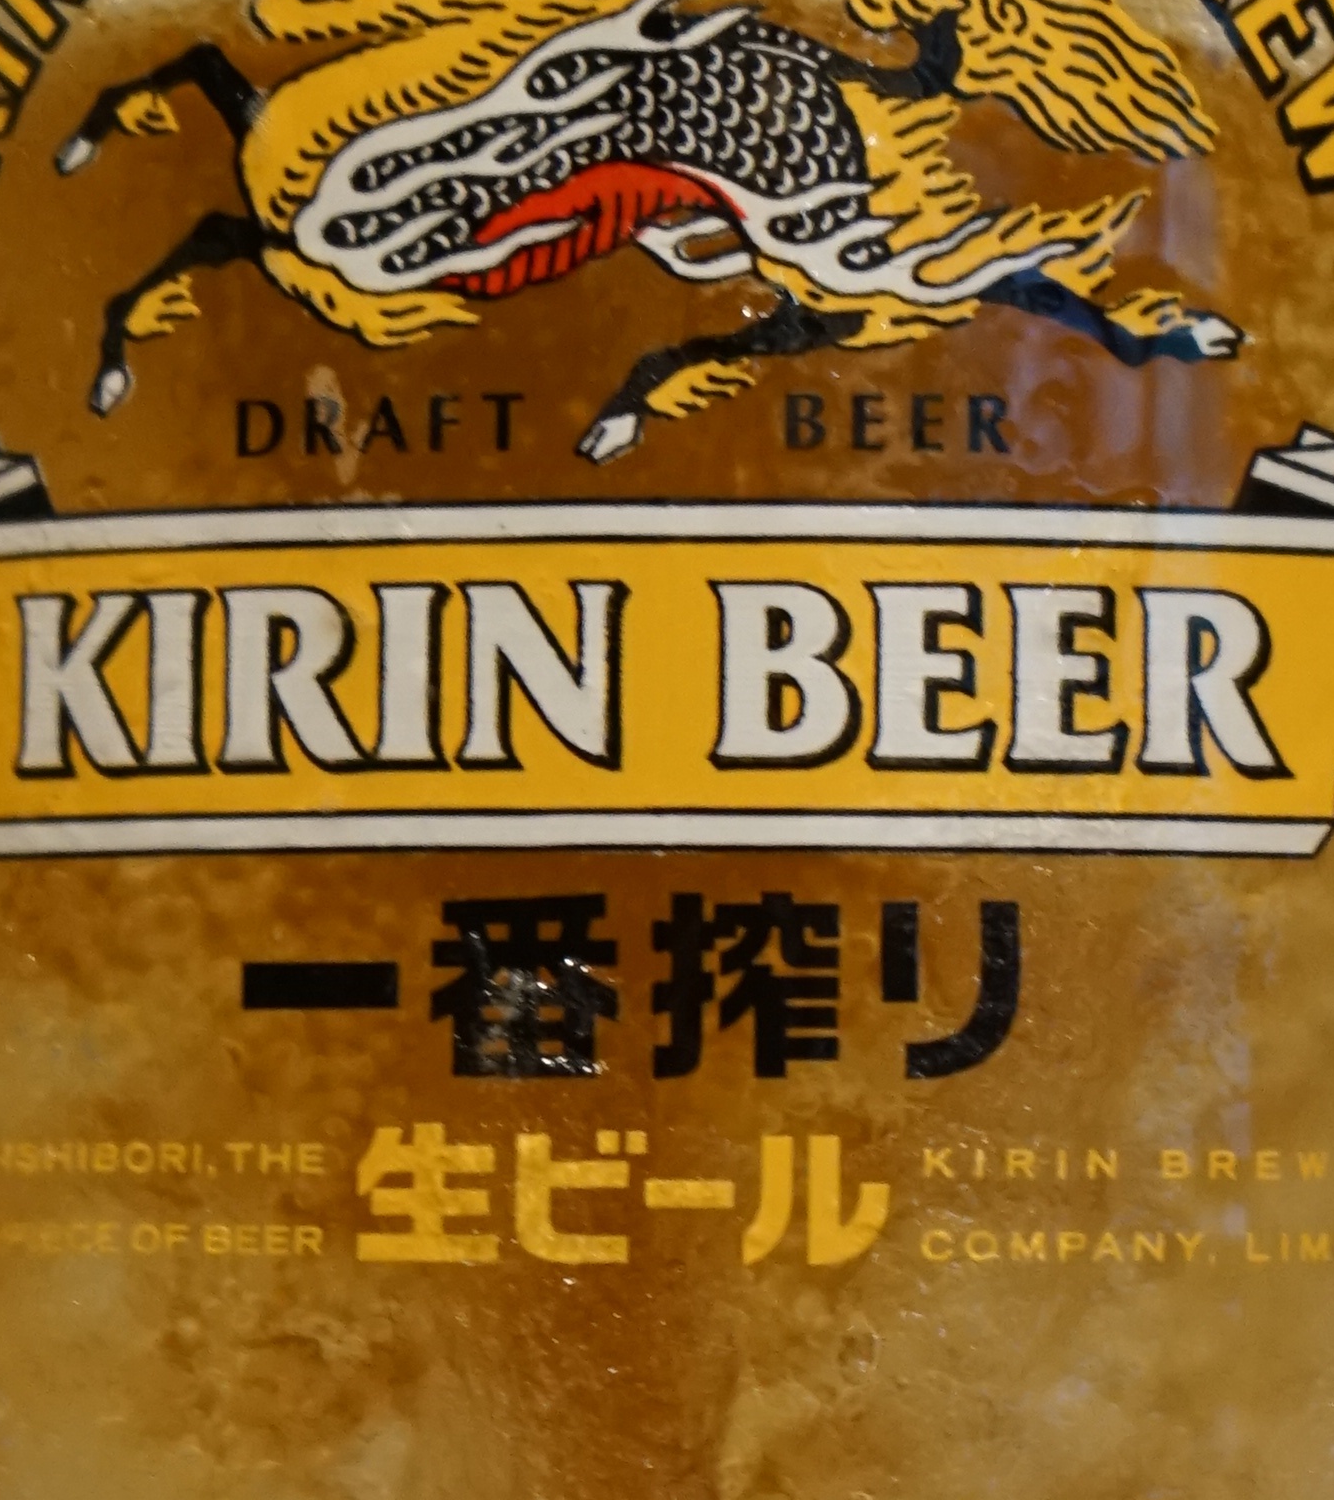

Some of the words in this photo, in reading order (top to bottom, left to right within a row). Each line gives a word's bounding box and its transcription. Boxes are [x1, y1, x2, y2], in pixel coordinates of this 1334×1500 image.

[234, 391, 525, 458] DRAFT
[784, 391, 1013, 455] BEER
[14, 580, 630, 779] KIRIN
[708, 580, 1295, 780] BEER
[240, 891, 1023, 1082] 一番搾り
[224, 1141, 326, 1175] THE
[921, 1147, 1120, 1181] KIRIN
[354, 1122, 891, 1270] 生ビール
[130, 1223, 192, 1255] OF
[203, 1223, 326, 1257] BEER
